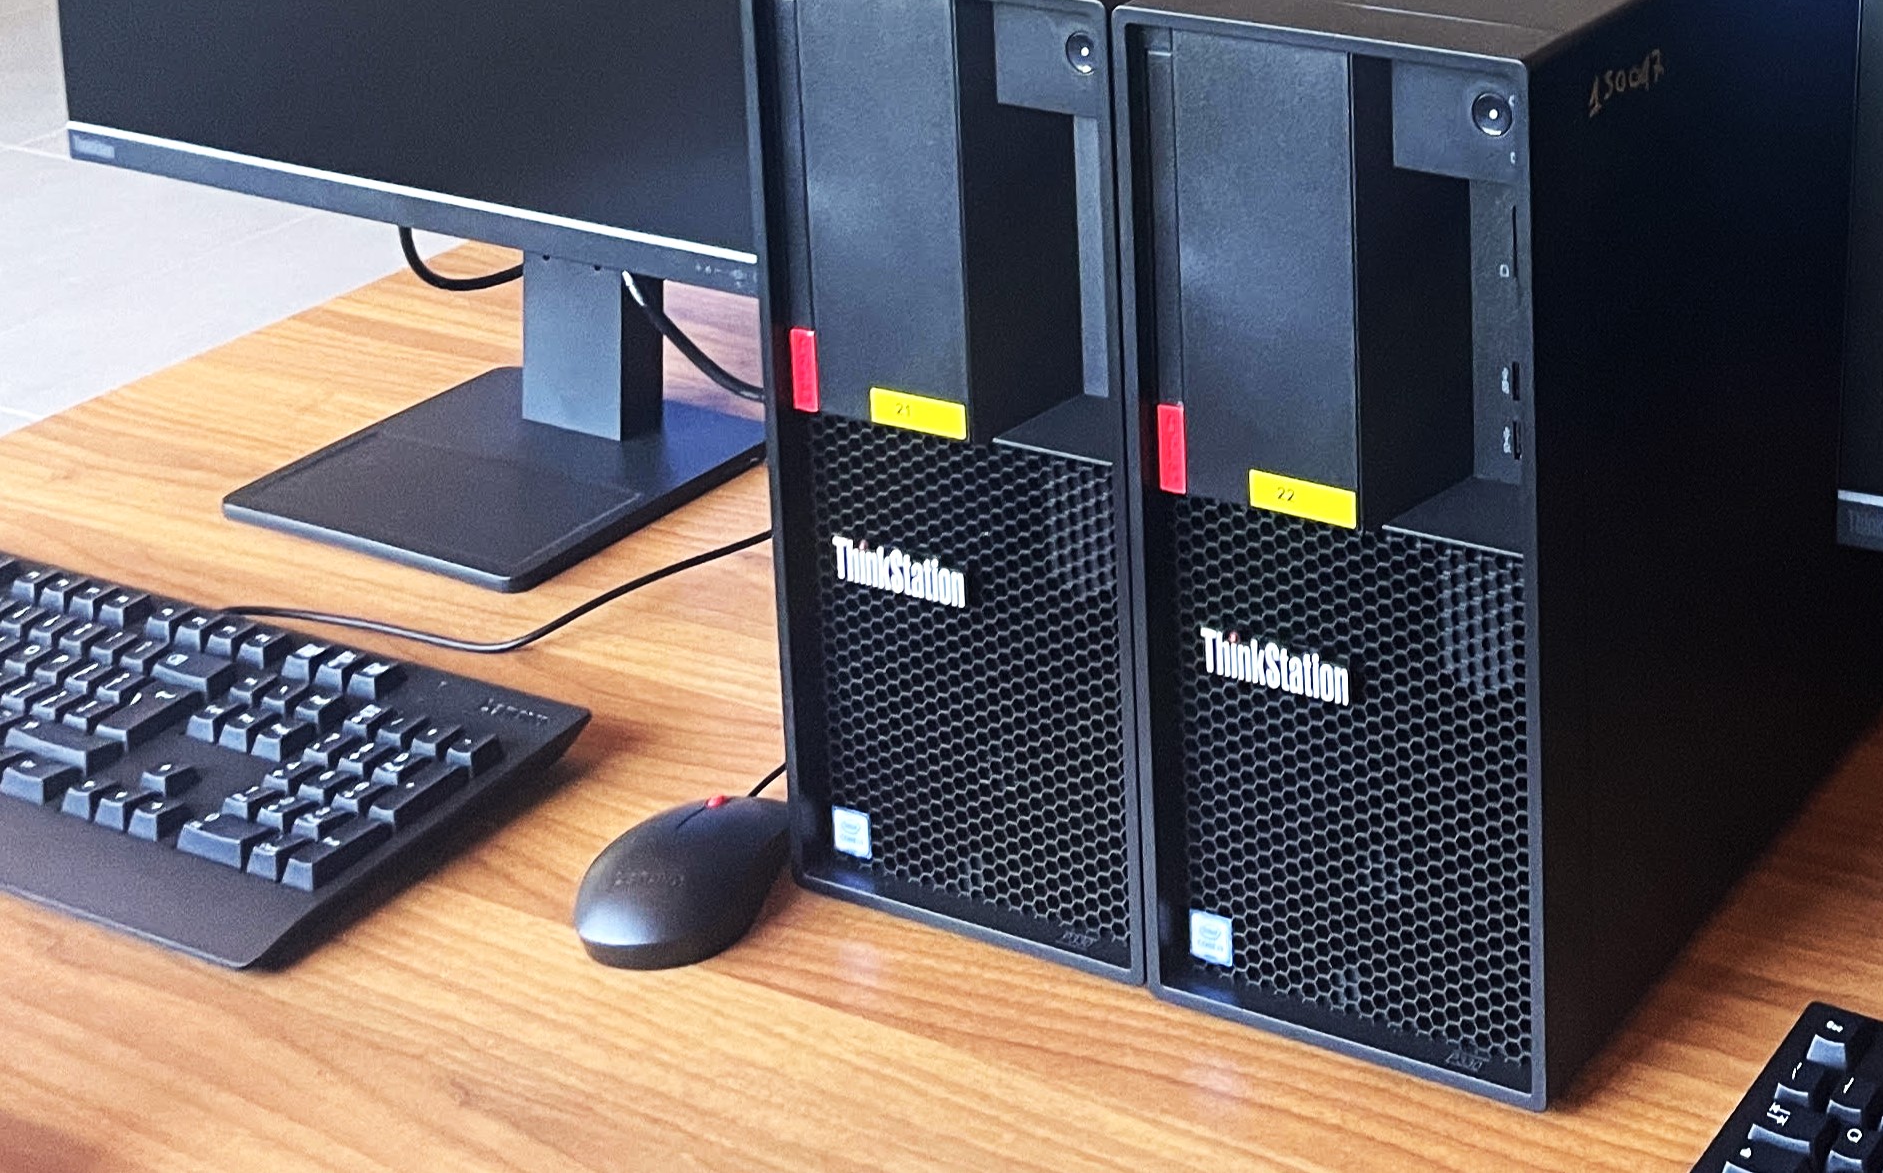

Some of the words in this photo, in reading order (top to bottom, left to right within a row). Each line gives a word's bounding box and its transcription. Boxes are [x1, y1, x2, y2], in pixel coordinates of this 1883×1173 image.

[895, 402, 911, 417] 21
[1276, 486, 1296, 503] 22
[831, 534, 966, 609] ThinkStation
[1200, 626, 1350, 707] ThinkStation
[1846, 1128, 1862, 1144] Q
